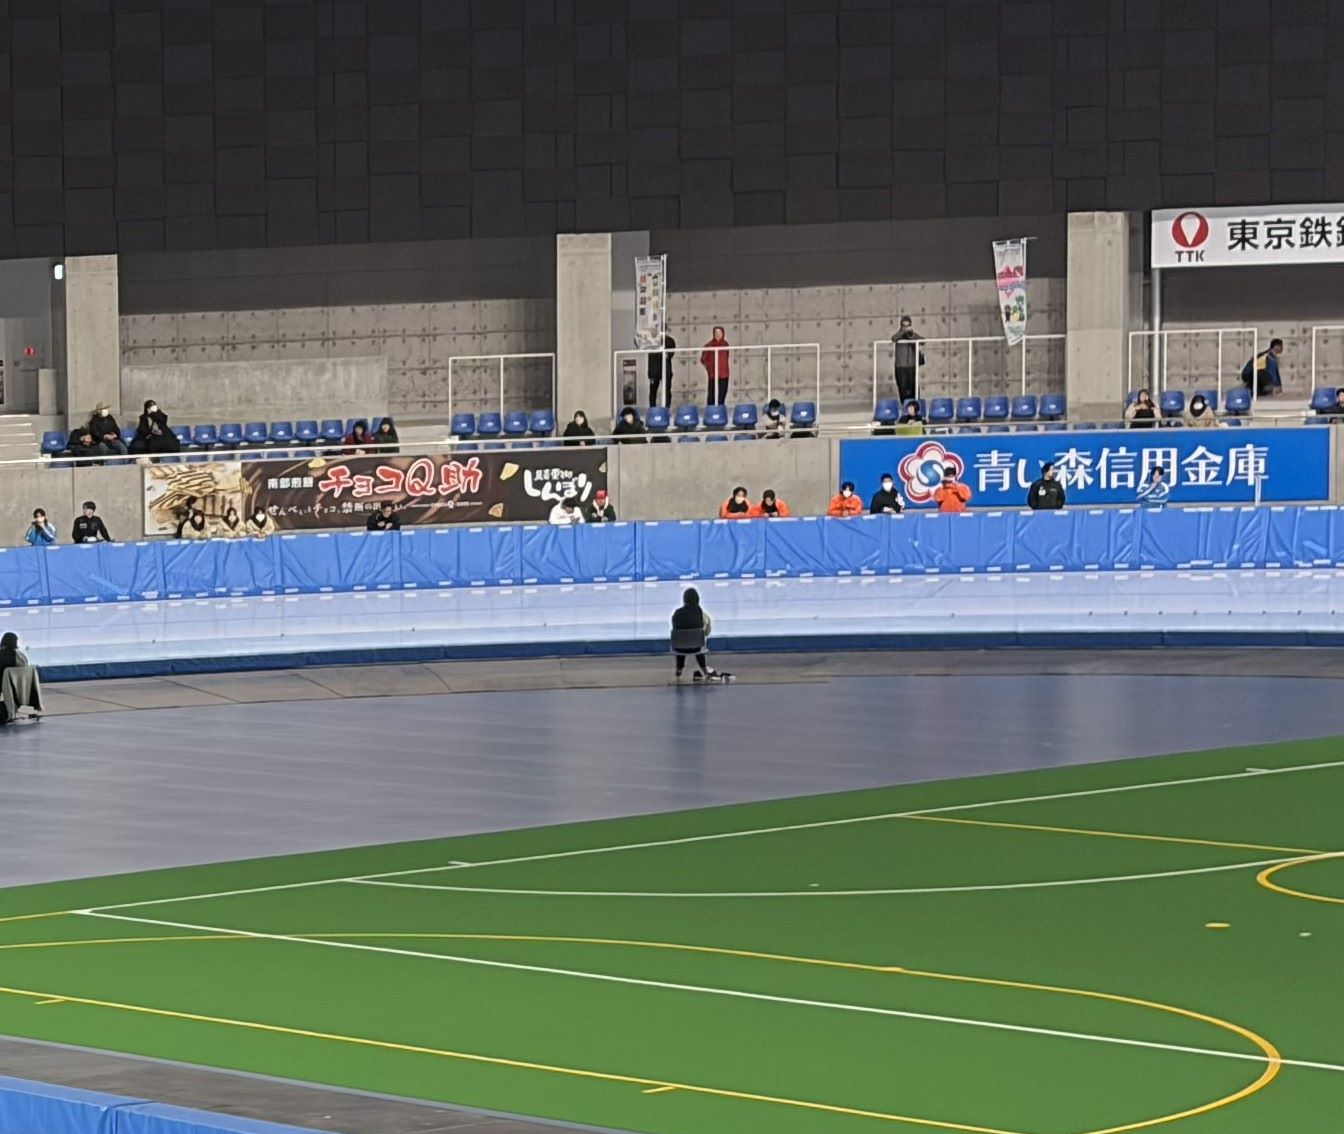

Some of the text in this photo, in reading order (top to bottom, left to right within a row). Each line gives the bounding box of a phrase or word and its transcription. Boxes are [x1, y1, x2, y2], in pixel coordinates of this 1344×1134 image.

[1227, 215, 1344, 251] 東京鉄
[1174, 249, 1206, 263] TTK
[318, 457, 484, 499] チョコQ助
[973, 443, 1270, 493] 青い森信用金庫
